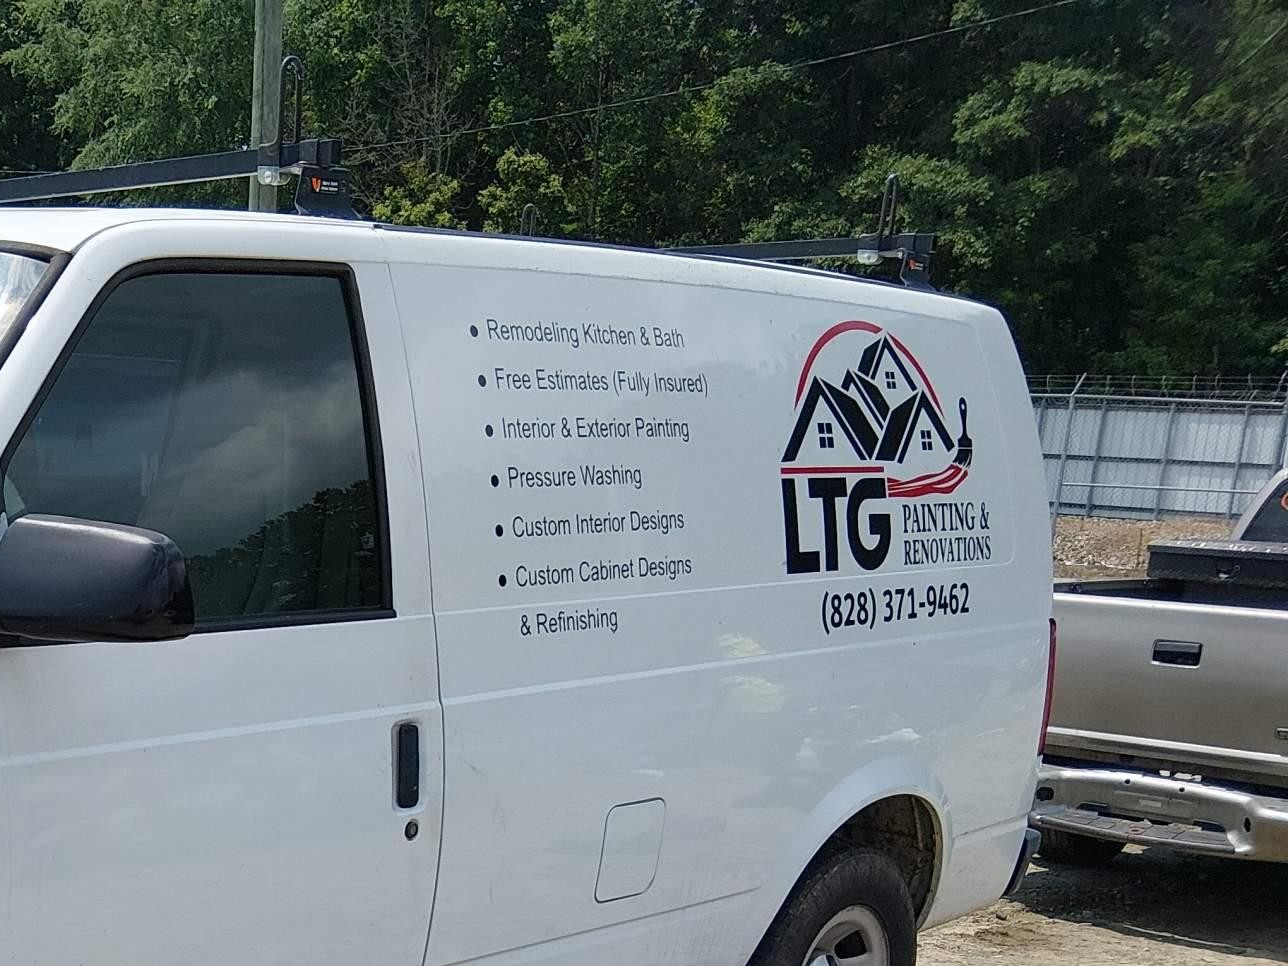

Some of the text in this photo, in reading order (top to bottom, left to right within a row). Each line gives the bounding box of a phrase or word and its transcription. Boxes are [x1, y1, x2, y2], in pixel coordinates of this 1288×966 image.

[486, 319, 685, 348] Remodeling Kitchen & Bath
[494, 367, 708, 398] Free Estimates (Fully Insured)
[502, 417, 690, 442] Interior & Exterior Painting
[507, 464, 642, 489] Pressure Washing
[512, 510, 685, 538] Custom Interior Designs
[781, 477, 892, 574] LTG
[902, 501, 991, 534] PAINTING &
[903, 535, 992, 566] RENOVATIONS
[515, 556, 693, 587] Custom Cabinet Designs
[520, 608, 619, 637] & Refinishing
[821, 582, 970, 635] (828) 371-9462
